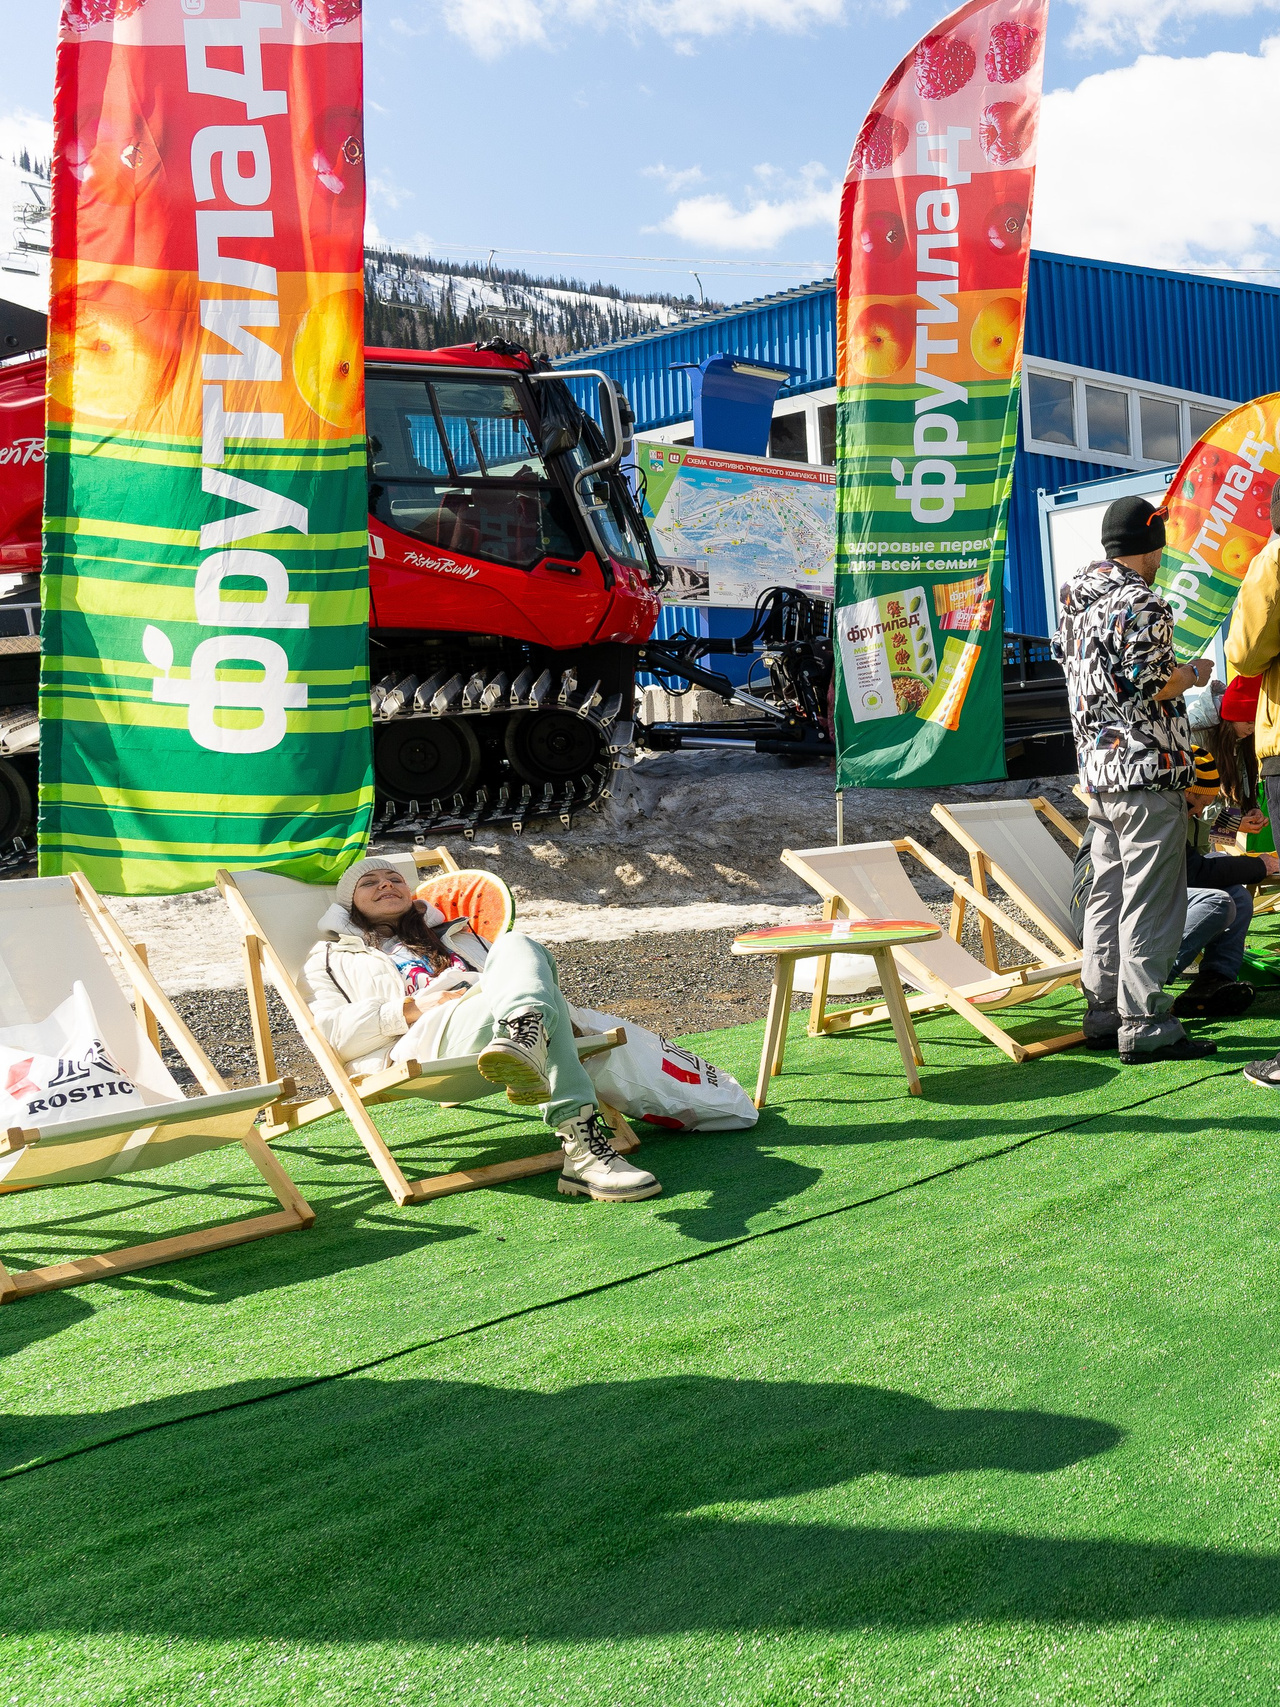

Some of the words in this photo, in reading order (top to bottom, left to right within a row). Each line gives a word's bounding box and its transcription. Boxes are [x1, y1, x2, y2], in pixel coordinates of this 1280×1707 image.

[891, 125, 972, 524] фрутилад
[143, 1, 310, 754] фрутилад
[687, 457, 708, 466] СХЕМА
[848, 541, 935, 557] здоровые
[940, 537, 994, 556] переку
[847, 560, 876, 573] для
[881, 556, 921, 571] всей
[926, 558, 978, 571] семьи
